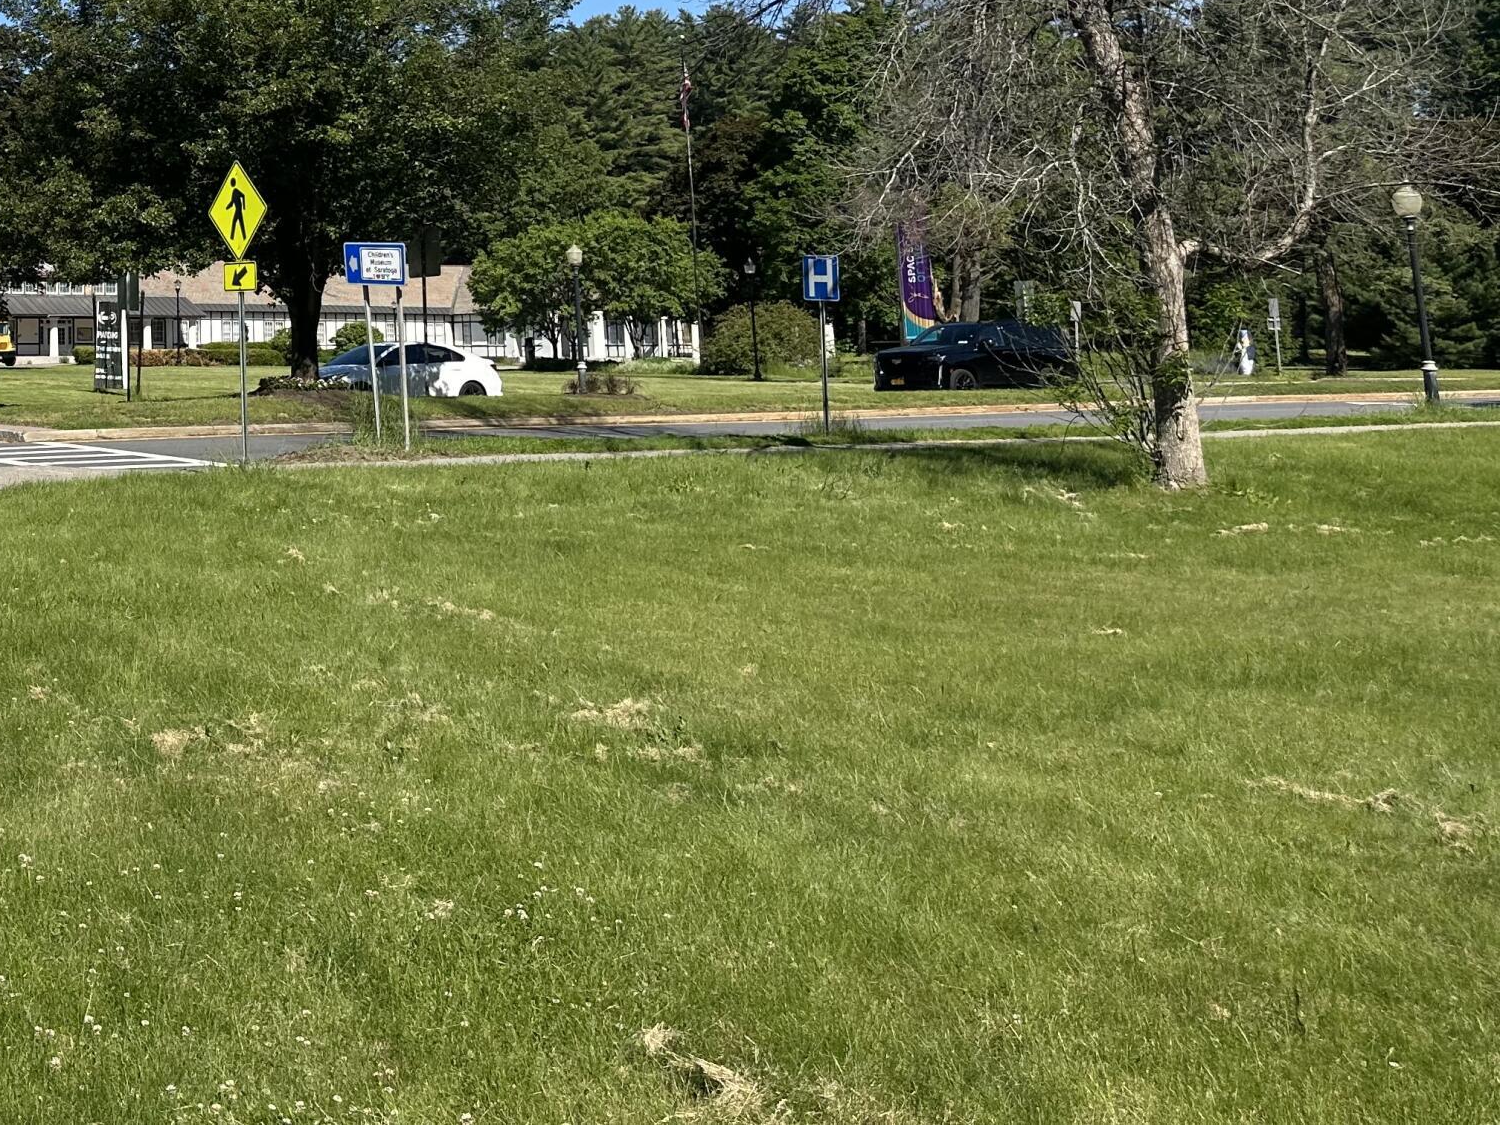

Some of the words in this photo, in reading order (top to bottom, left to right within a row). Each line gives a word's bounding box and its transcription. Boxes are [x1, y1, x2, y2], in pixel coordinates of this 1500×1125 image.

[374, 267, 397, 275] Saratoga
[808, 258, 833, 297] H
[906, 255, 916, 283] SPAC
